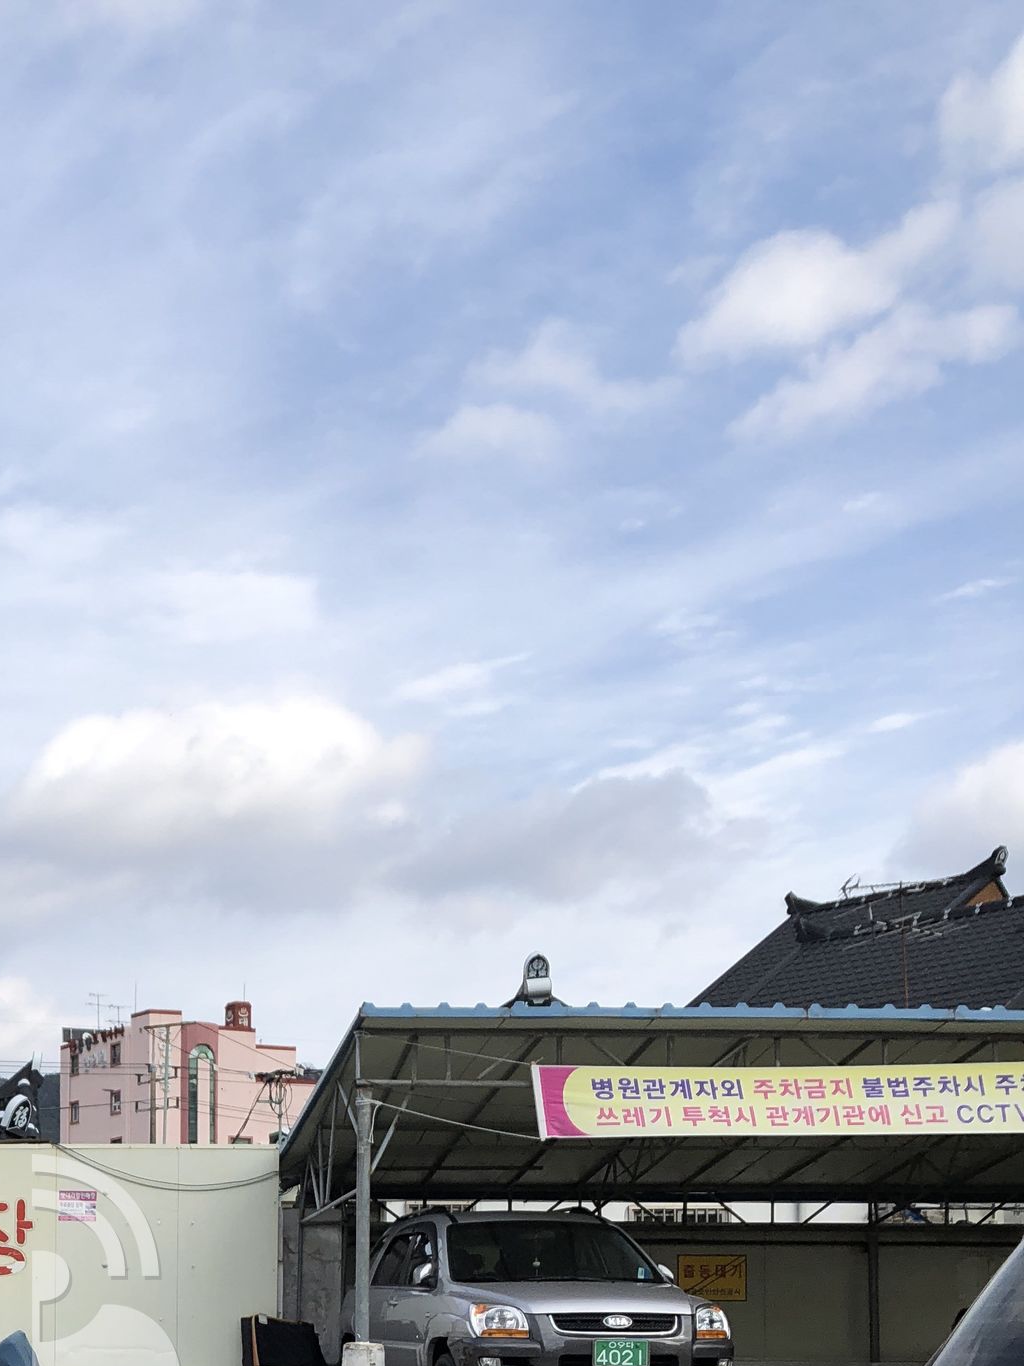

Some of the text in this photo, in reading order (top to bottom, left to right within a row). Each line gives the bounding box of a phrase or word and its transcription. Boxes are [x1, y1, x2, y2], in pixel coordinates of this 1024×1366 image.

[590, 1077, 745, 1101] 병원관계자외
[752, 1077, 854, 1100] 주차금지
[861, 1074, 986, 1098] 불법주차시
[596, 1106, 673, 1128] 쓰레기
[682, 1104, 757, 1127] 투척시
[766, 1103, 891, 1127] 관계기관에
[900, 1103, 948, 1125] 신고
[608, 1317, 628, 1326] KIA
[596, 1349, 642, 1366] 4021
